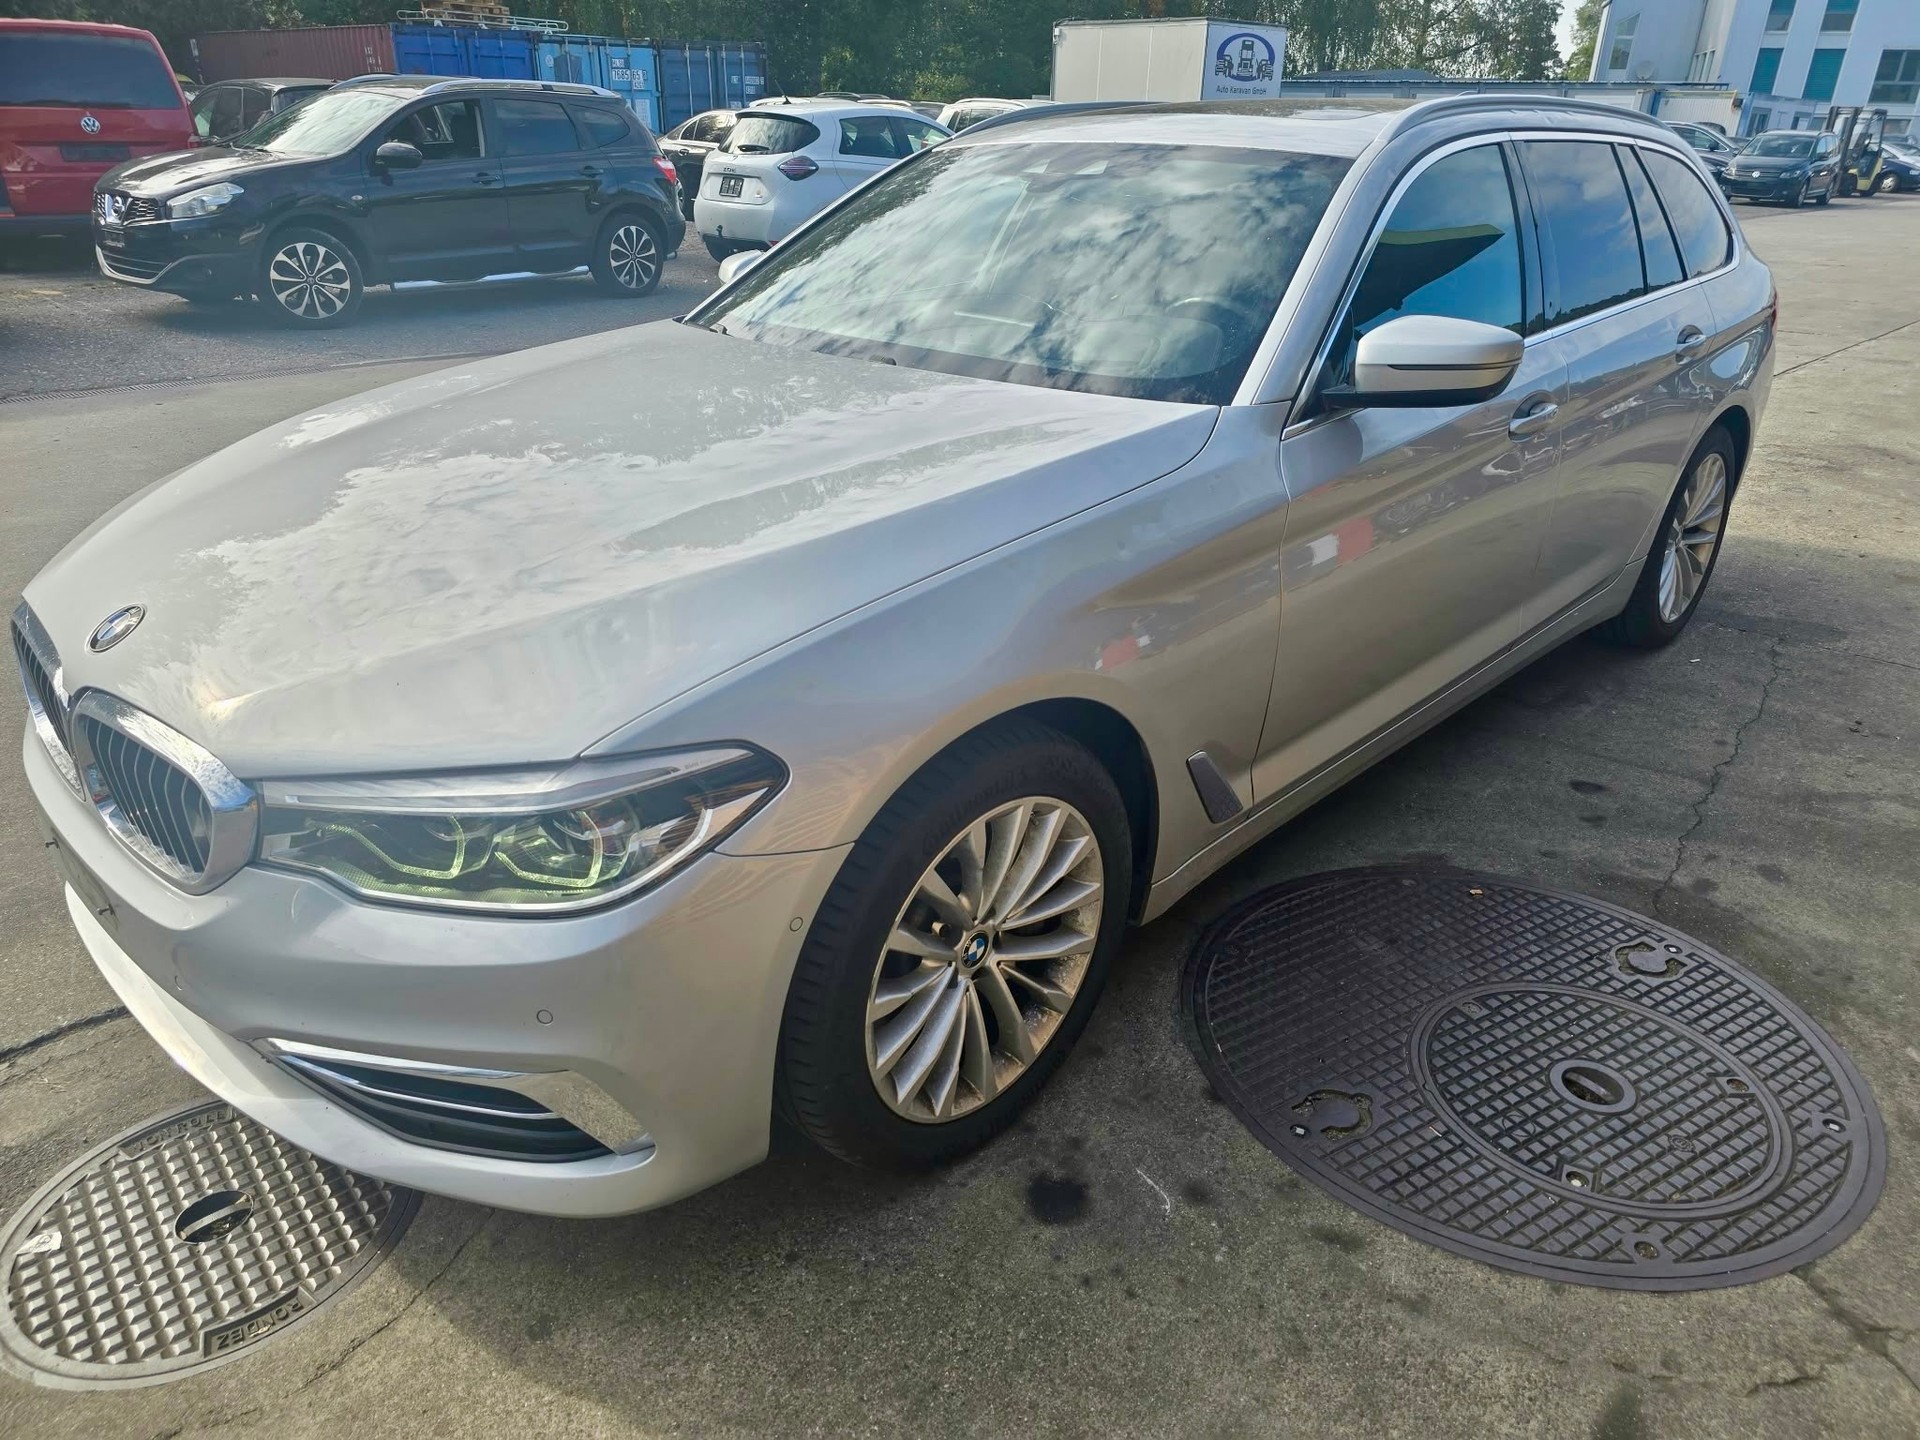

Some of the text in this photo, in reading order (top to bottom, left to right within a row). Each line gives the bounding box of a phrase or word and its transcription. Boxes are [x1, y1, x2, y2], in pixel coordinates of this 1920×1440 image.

[1216, 85, 1267, 95] Auto Karavan GmbH
